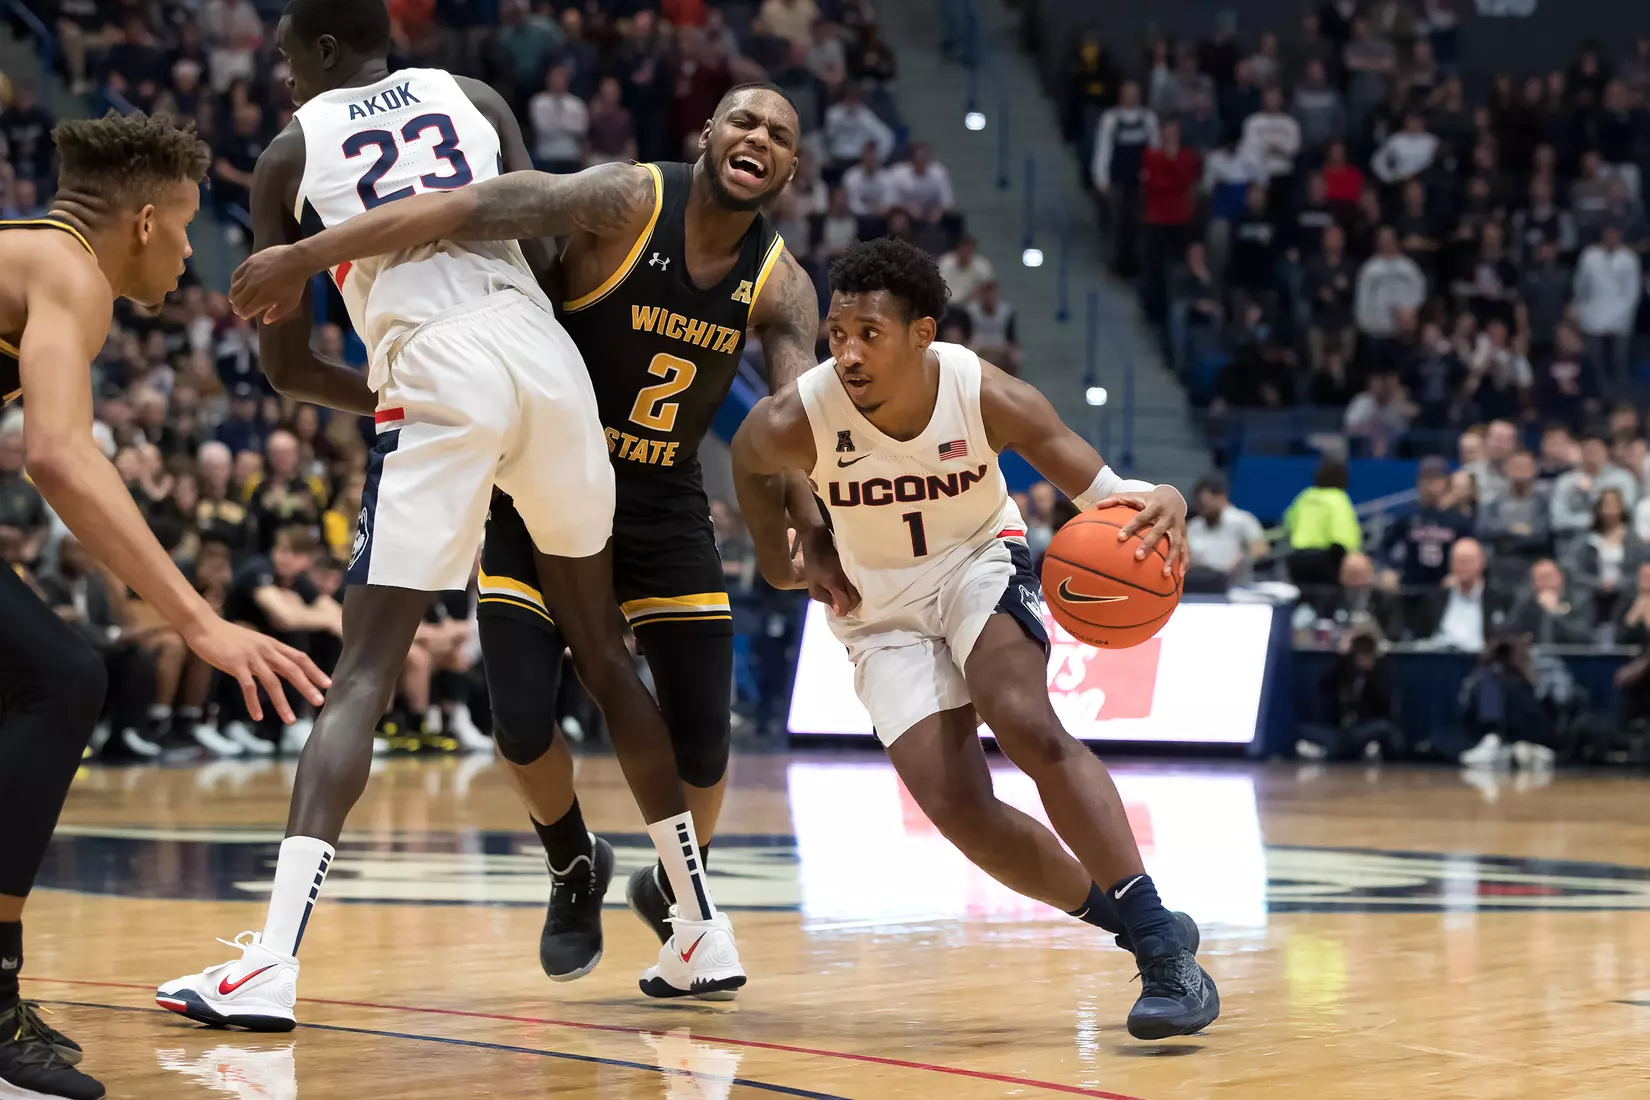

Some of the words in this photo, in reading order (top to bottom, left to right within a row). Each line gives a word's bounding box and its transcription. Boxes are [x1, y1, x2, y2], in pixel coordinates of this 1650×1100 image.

[349, 82, 421, 120] AKOK
[342, 113, 474, 211] 23
[631, 304, 741, 354] WICHITA
[628, 352, 697, 432] 2
[604, 426, 680, 466] STATE
[828, 464, 988, 507] UCONN
[902, 511, 928, 557] 1
